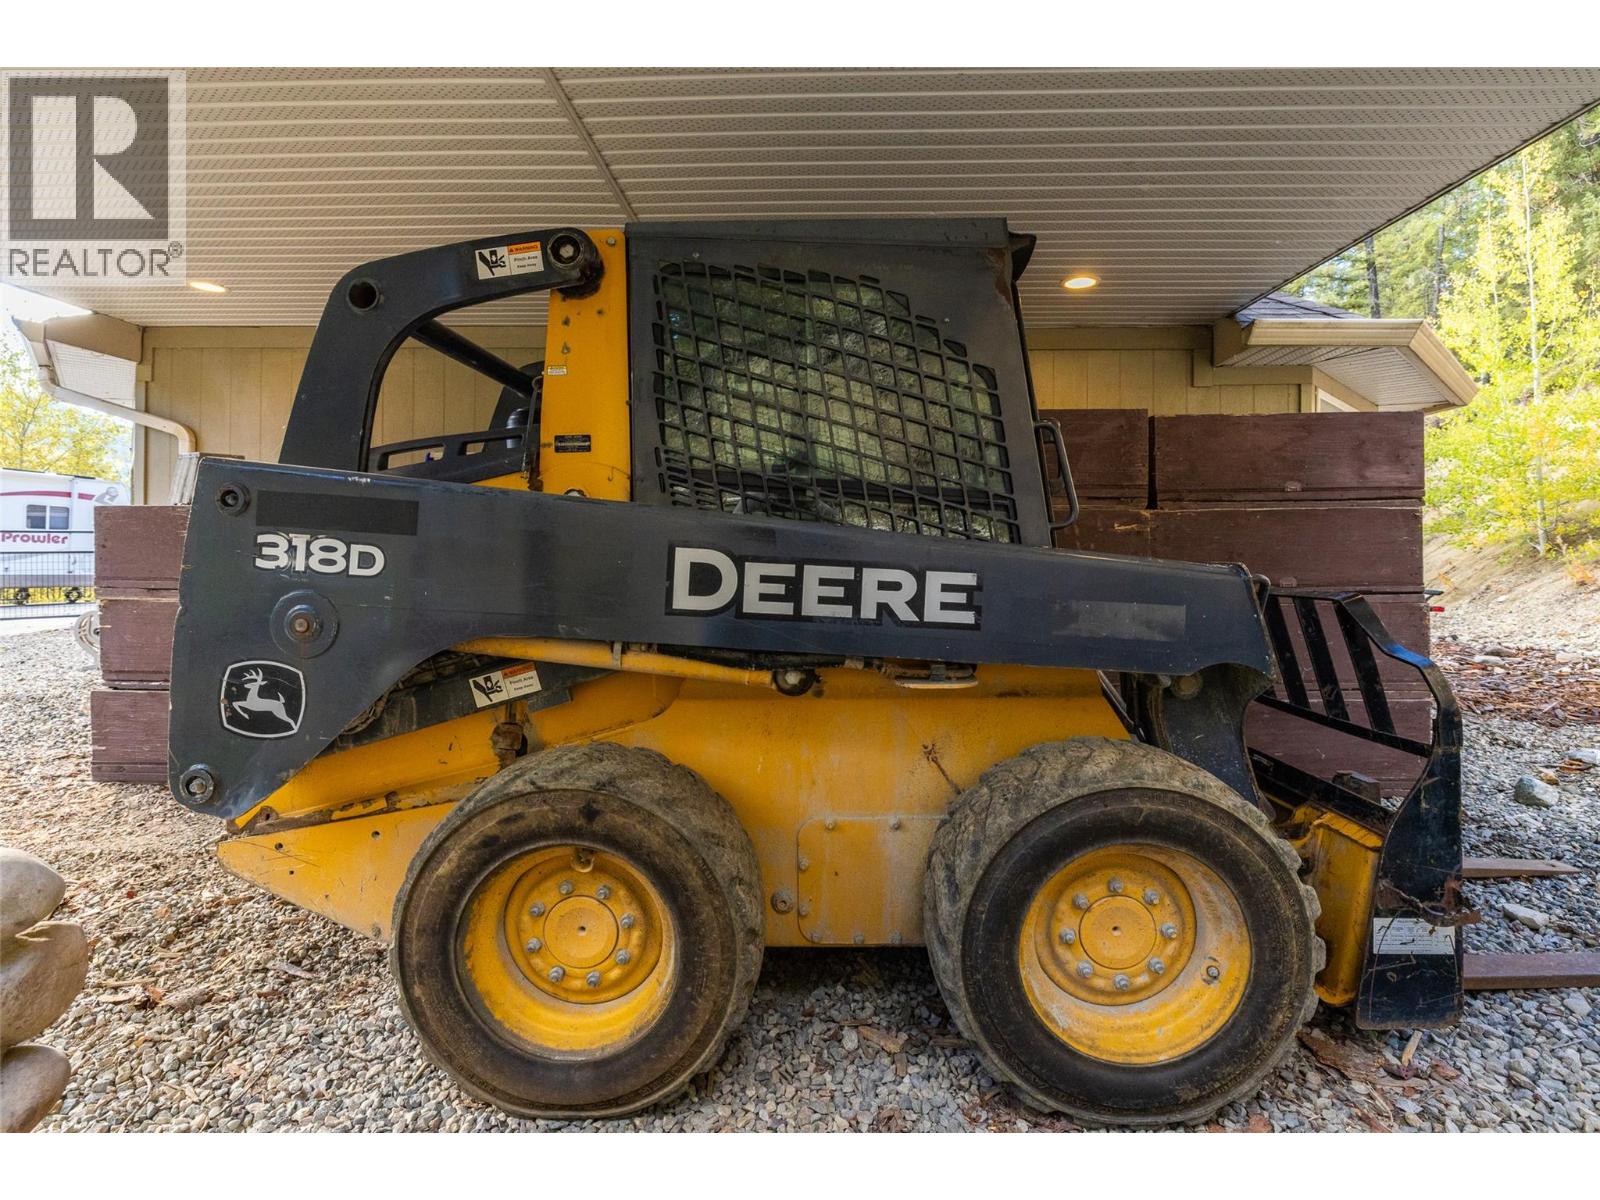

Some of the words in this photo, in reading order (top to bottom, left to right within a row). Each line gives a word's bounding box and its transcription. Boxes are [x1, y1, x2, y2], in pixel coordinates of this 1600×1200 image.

[1, 532, 68, 544] Prowler
[255, 533, 386, 577] 318D
[672, 546, 978, 625] DEERE
